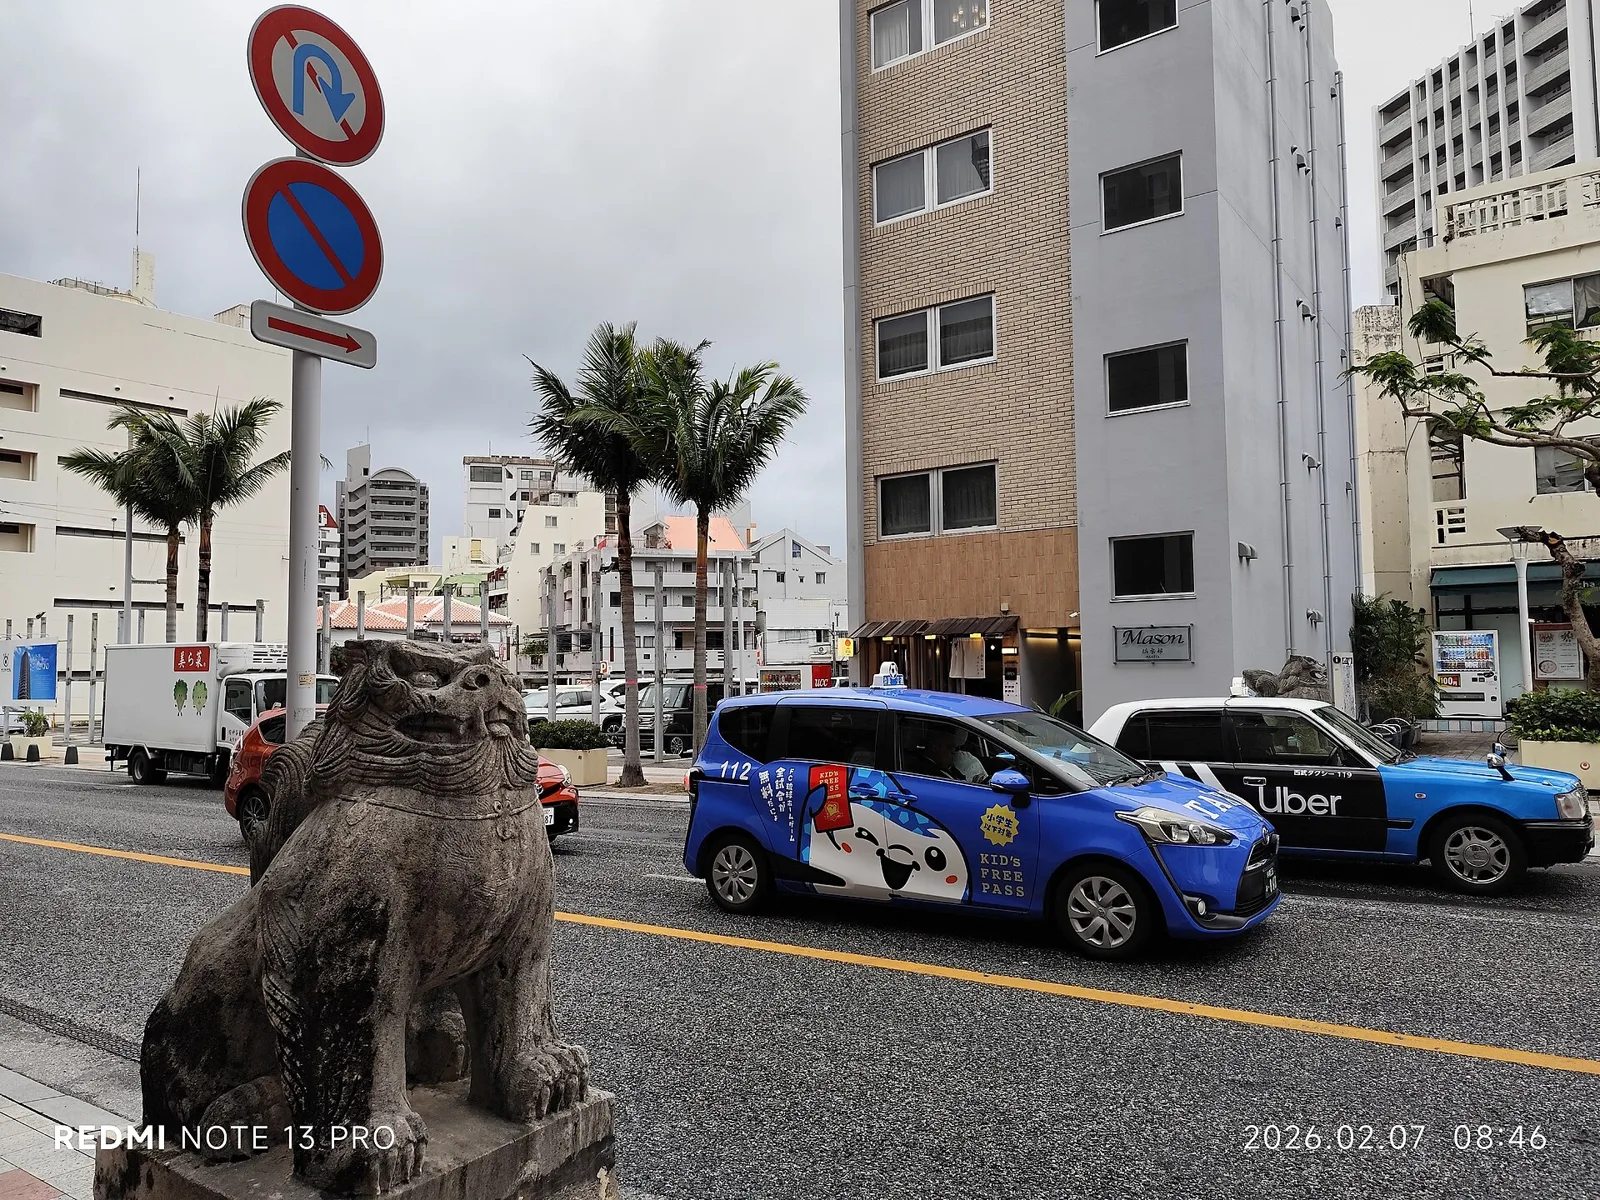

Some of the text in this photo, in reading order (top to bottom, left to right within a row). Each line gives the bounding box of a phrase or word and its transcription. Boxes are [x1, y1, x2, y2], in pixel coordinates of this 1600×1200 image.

[1122, 629, 1184, 645] Mason
[178, 650, 203, 668] 美ら菜
[720, 760, 752, 780] 112
[1293, 769, 1353, 779] 西武タクシー 119
[1258, 786, 1342, 816] Uber
[986, 813, 1013, 829] 小学生
[980, 853, 1021, 867] KID's
[980, 868, 1023, 882] FREE
[982, 882, 1025, 897] PASS
